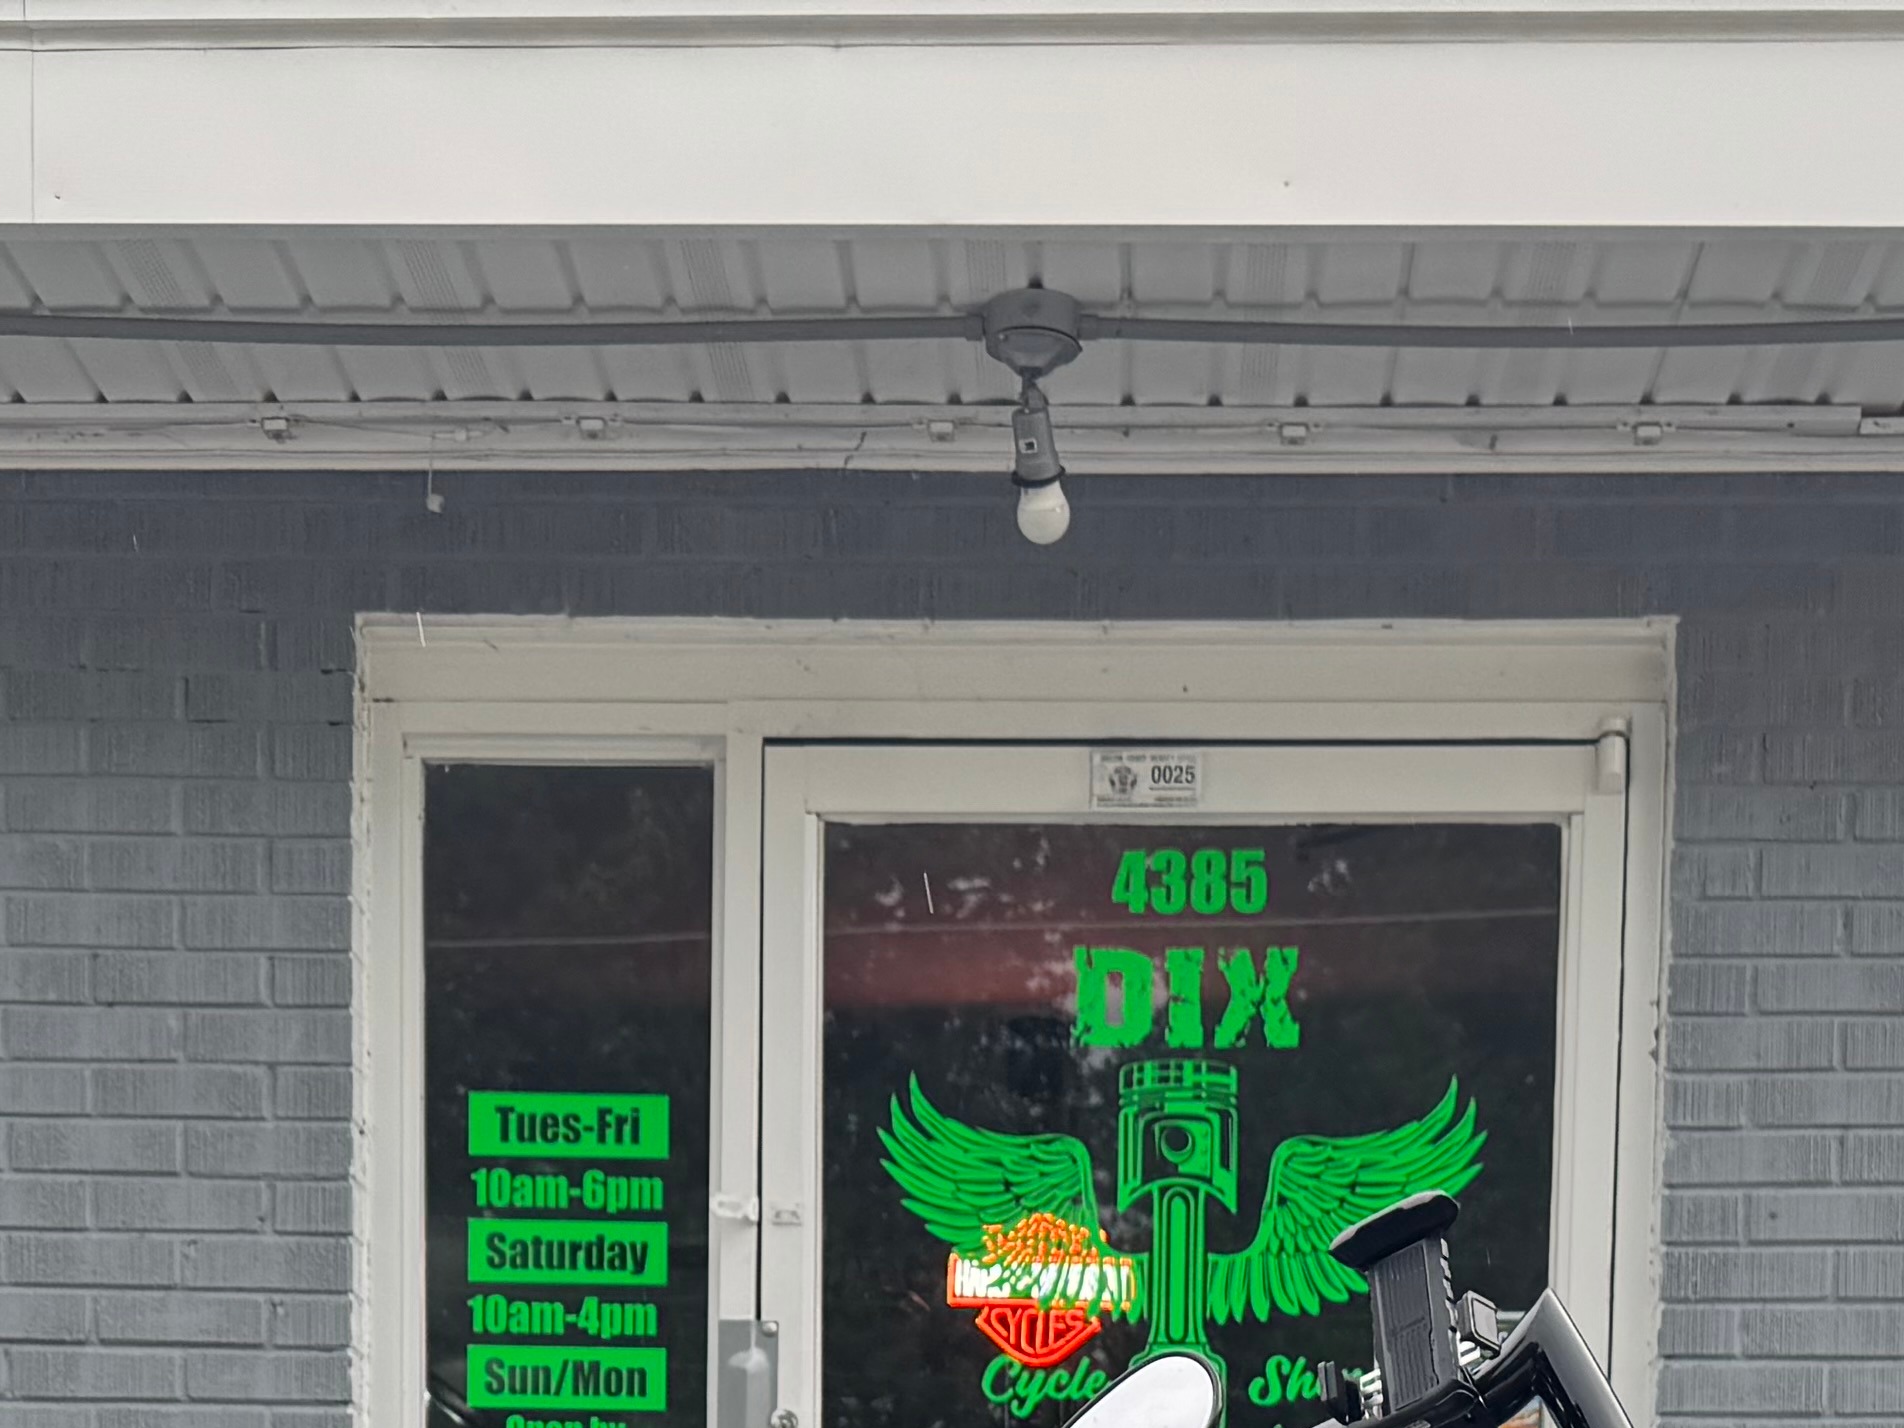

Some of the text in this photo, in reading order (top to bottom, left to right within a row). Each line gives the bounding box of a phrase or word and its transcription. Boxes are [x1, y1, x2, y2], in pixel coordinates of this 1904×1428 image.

[1151, 765, 1195, 784] 0025
[1112, 849, 1267, 914] 4385
[1072, 946, 1300, 1049] DIX
[495, 1105, 640, 1146] Tues-Fri
[471, 1168, 664, 1214] 10am-6pm
[485, 1232, 649, 1276] Saturday
[467, 1294, 658, 1339] 10am-4pm
[991, 1308, 1085, 1355] CYCLES
[484, 1357, 648, 1398] Sun/Mon
[982, 1354, 1362, 1418] Cycle Sh
